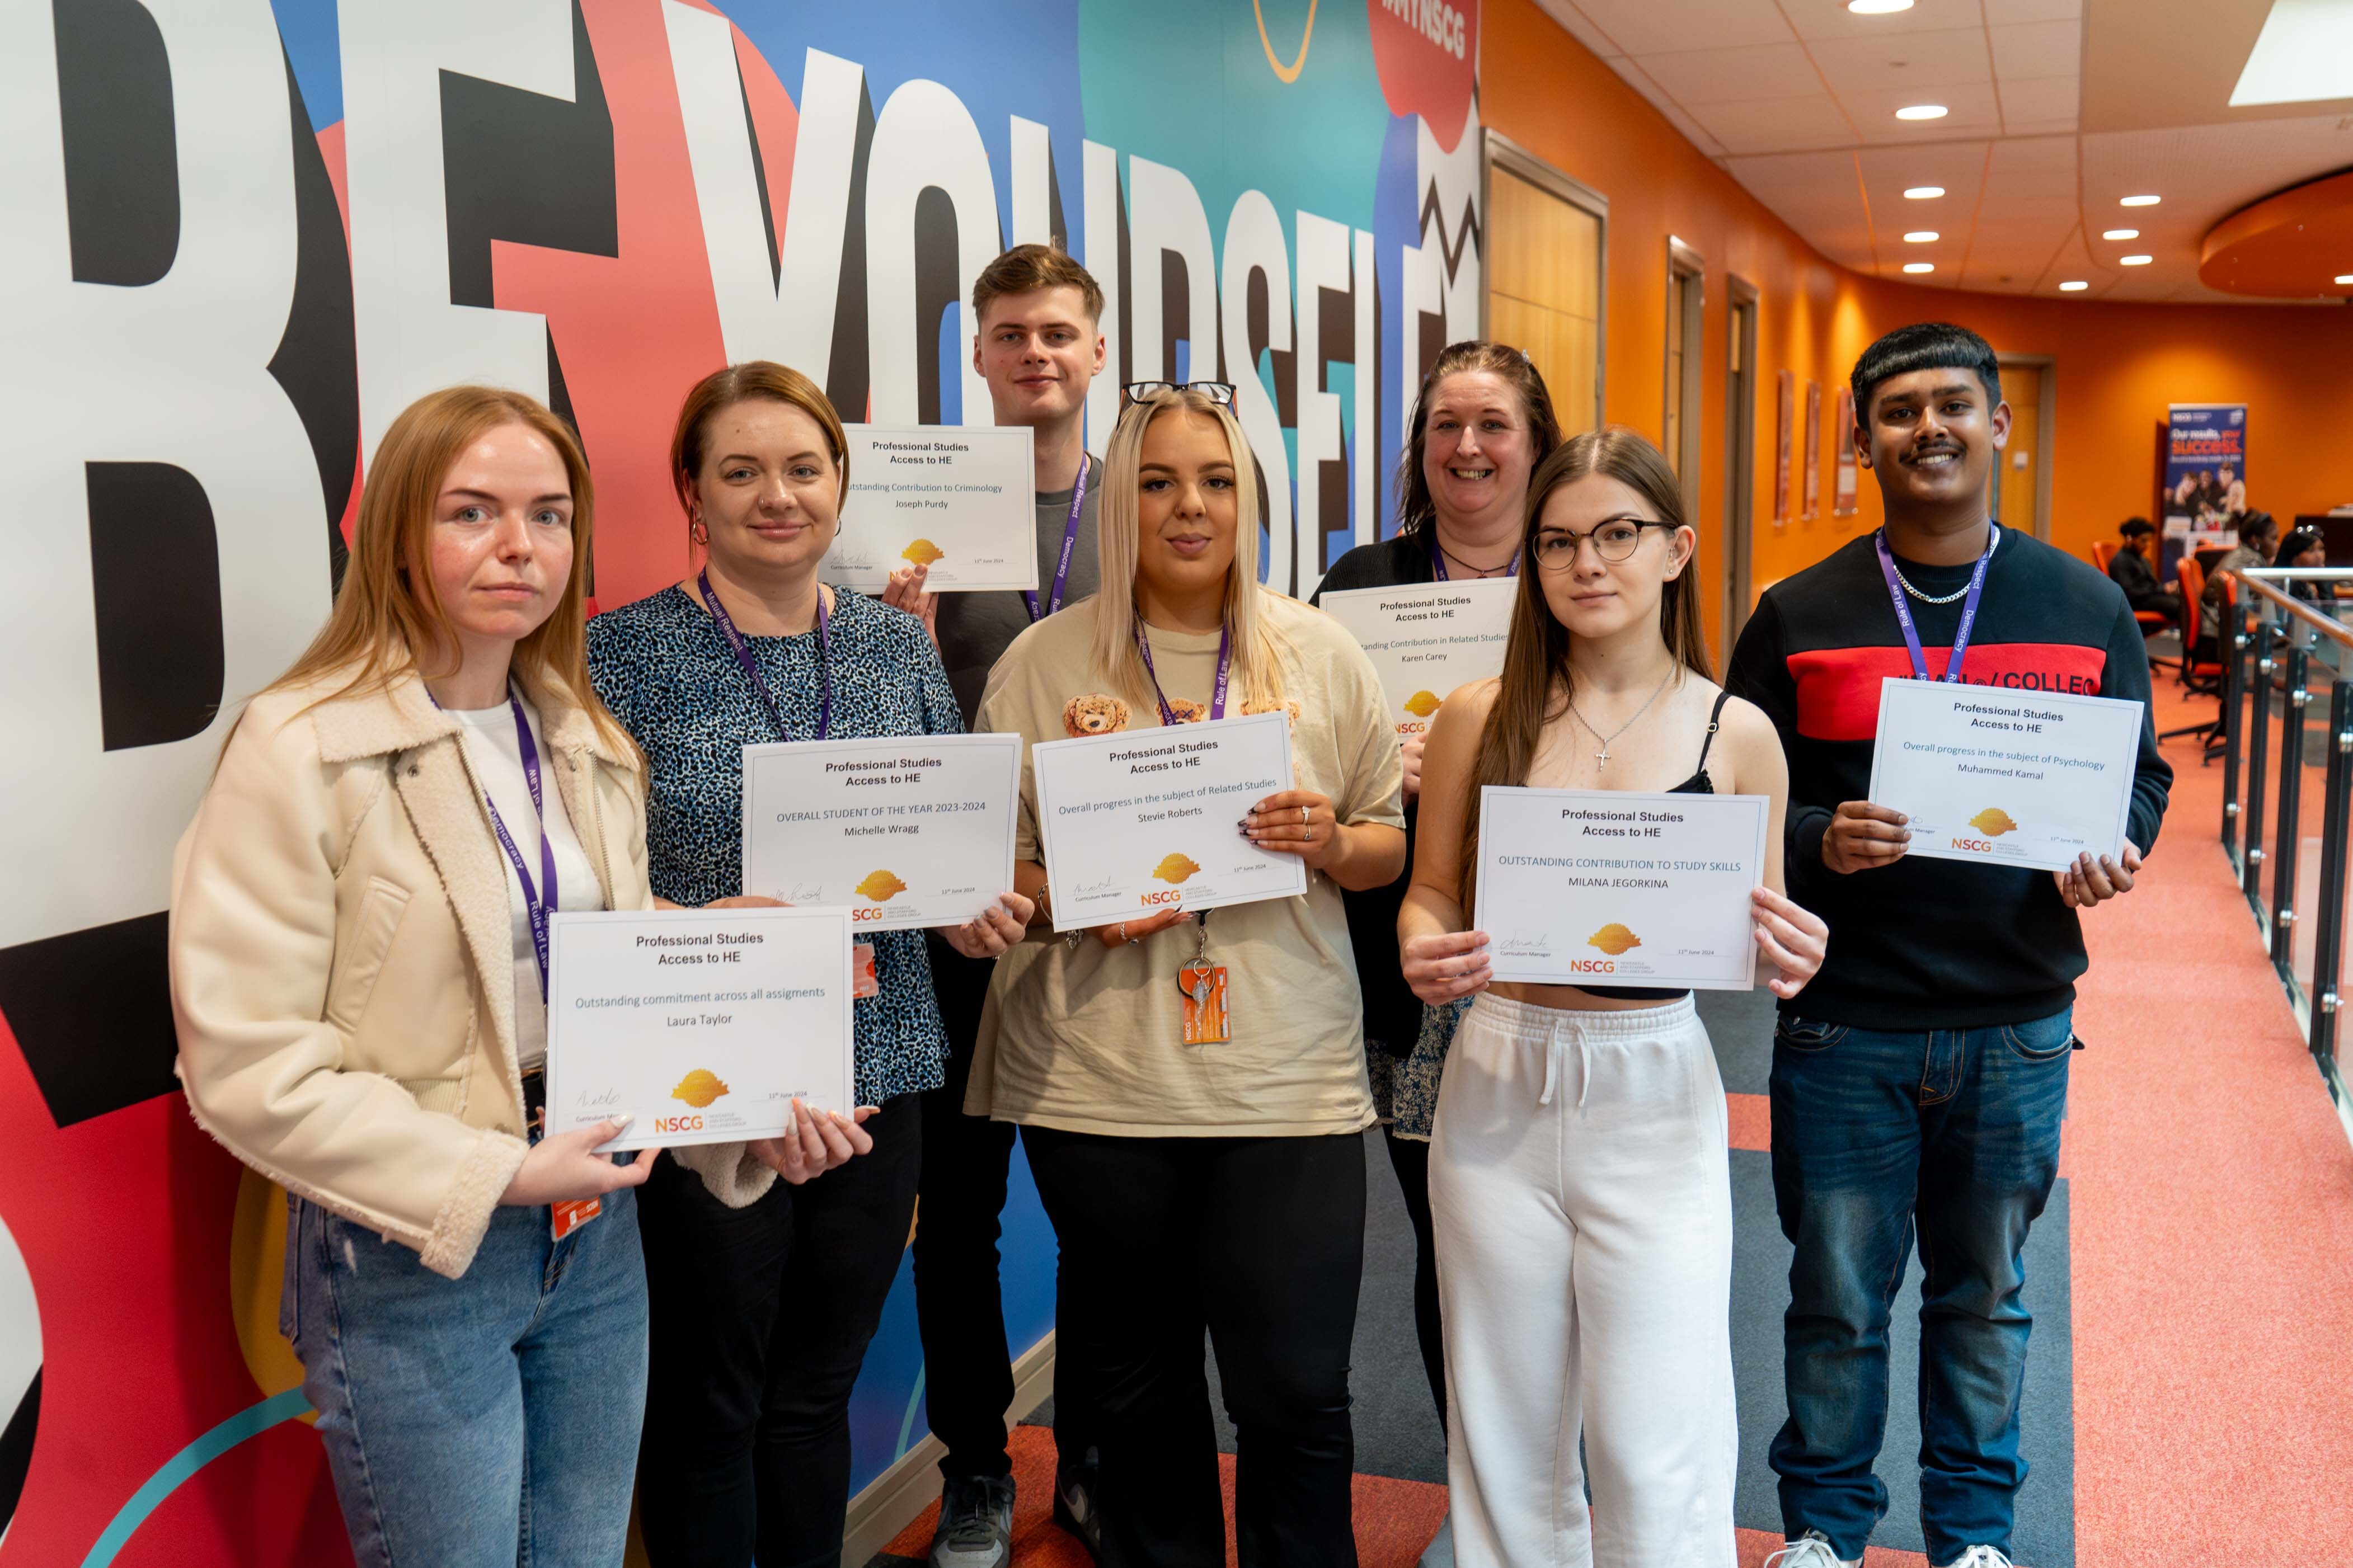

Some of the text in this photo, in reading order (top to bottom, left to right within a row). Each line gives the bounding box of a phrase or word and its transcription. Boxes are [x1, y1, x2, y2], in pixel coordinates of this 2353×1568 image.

[873, 442, 931, 450] Professional
[890, 455, 923, 464] Access
[849, 484, 889, 493] utstanding
[892, 483, 942, 492] Contribution
[955, 484, 1002, 493] Criminology
[896, 500, 947, 509] Joseph Purdy
[1072, 489, 1084, 518] Respect
[1058, 536, 1073, 578] Democracy
[1973, 560, 1987, 589] Respect
[1892, 585, 1902, 601] Law
[1380, 597, 1471, 611] Professional Studies
[706, 591, 744, 653] Mutual Respect
[1900, 609, 1910, 627] Rule
[1955, 610, 1974, 652] Democracy
[1391, 638, 1437, 648] Contribution
[1449, 634, 1478, 643] Related
[1215, 685, 1225, 705] Rule
[1158, 690, 1173, 726] Democra
[1954, 703, 2063, 721] Professional Studies
[1971, 718, 2042, 733] Access to HE
[1110, 741, 1218, 761] Professional Studies
[1904, 742, 1934, 752] Overall
[1937, 745, 1975, 757] progress
[1989, 750, 2003, 758] the
[2007, 752, 2039, 762] subject
[2054, 756, 2105, 771] Psychology
[826, 758, 941, 773] Professional Studies
[1131, 763, 1168, 774] Access
[1186, 757, 1200, 766] HE
[1958, 764, 2043, 780] Muhammed Kamal
[846, 777, 886, 786] Access
[905, 773, 920, 783] HE
[1059, 802, 1091, 814] Overall
[1094, 799, 1131, 812] progress
[1145, 794, 1159, 803] the
[1163, 790, 1194, 801] subject
[1197, 787, 1205, 796] of
[1209, 783, 1242, 794] Related
[1245, 779, 1276, 790] Studies
[777, 802, 985, 822] OVERALL STUDENT OF THE YEAR 2023-2024
[1138, 808, 1202, 822] Stevie Roberts
[1562, 809, 1683, 822] Professional Studies
[845, 825, 918, 836] Michelle Wragg
[1582, 826, 1661, 837] Access to HE
[490, 807, 524, 870] Democracy
[1952, 839, 1991, 852] NSCG
[1499, 856, 1740, 871] OUTSTANDING CONTRIBUTION TO STUDY SKILLS
[1569, 878, 1668, 888] MILANA JEGORKINA
[1074, 893, 1100, 902] Curriculum
[1141, 889, 1181, 906] NSCG
[853, 907, 882, 921] SCG
[530, 901, 548, 969] Rule of Law
[637, 933, 763, 947] Professional Studies
[659, 952, 740, 965] Access to HE
[1571, 960, 1614, 973] NSCG
[576, 988, 825, 1009] Outstanding commitment across all assigments
[668, 1014, 732, 1027] Laura Taylor
[655, 1115, 703, 1133] NSCG
